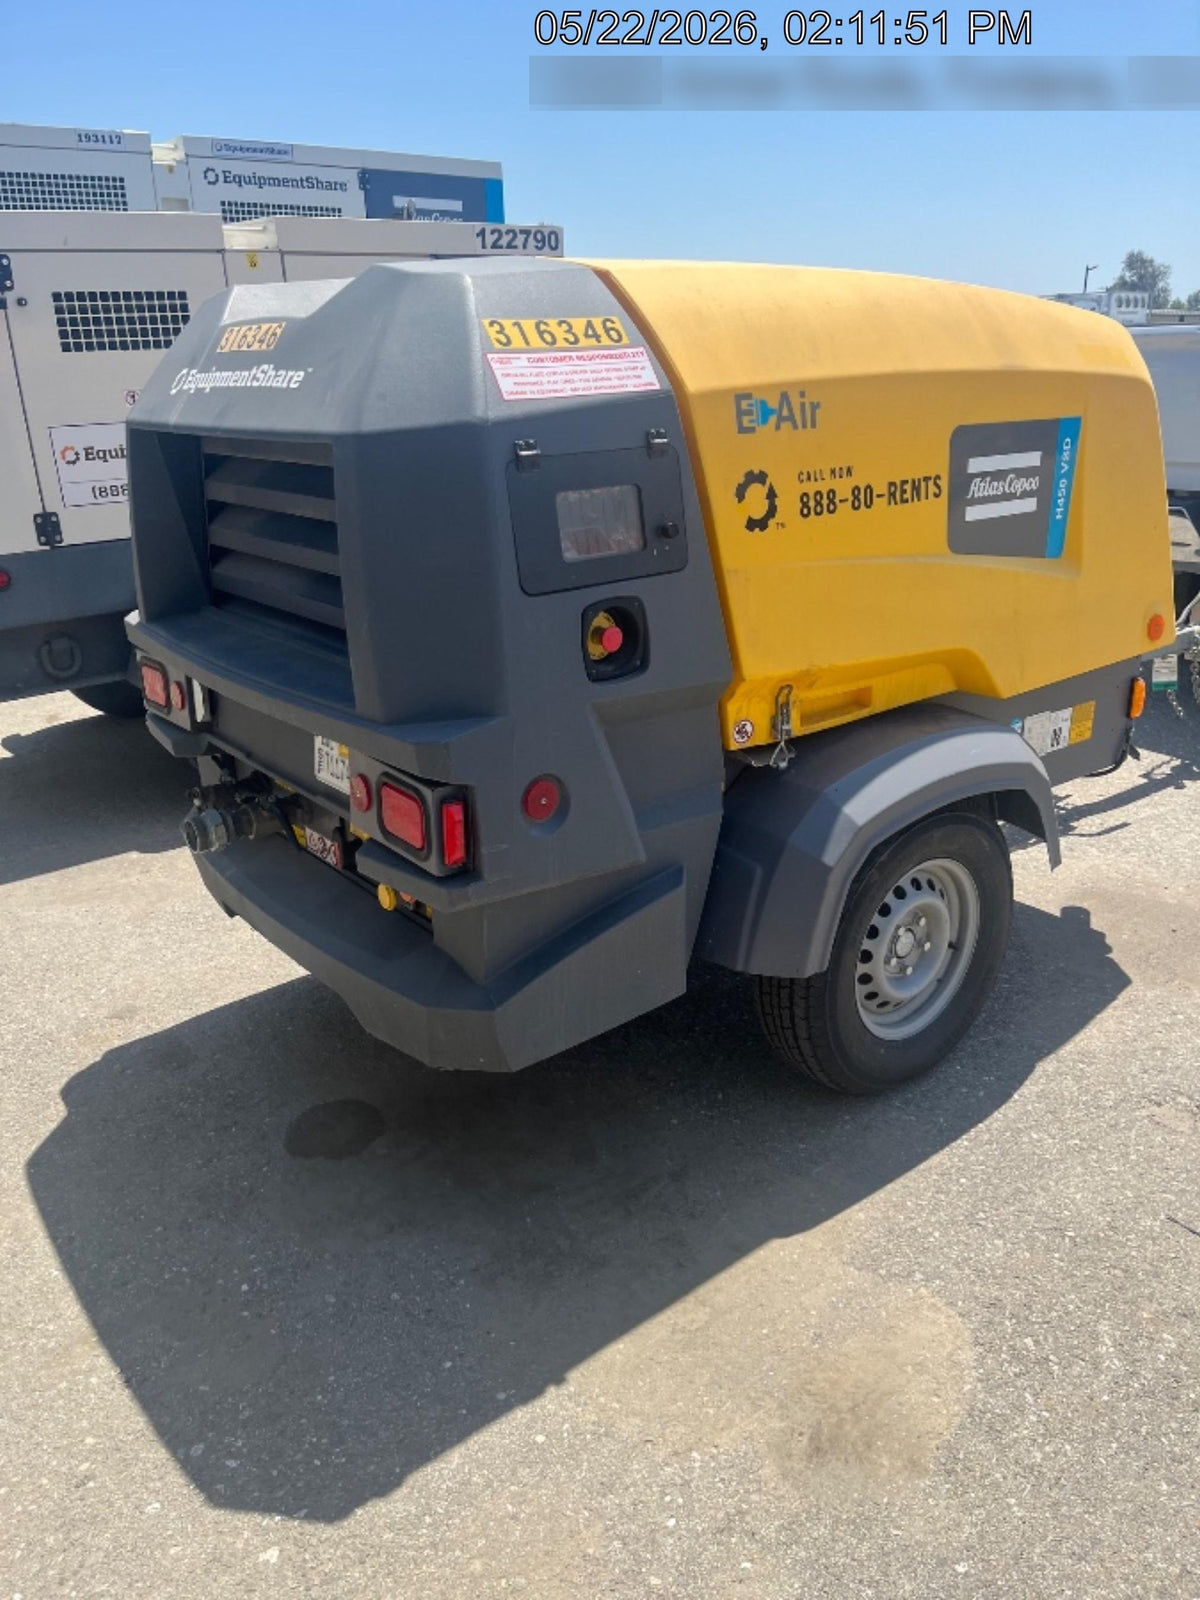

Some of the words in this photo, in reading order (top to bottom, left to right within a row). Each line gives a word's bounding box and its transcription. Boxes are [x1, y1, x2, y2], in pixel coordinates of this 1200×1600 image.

[222, 170, 348, 192] EquipmentShare
[475, 226, 560, 251] 122790
[219, 323, 284, 351] 316346
[488, 317, 624, 347] 316346
[182, 363, 305, 394] EquipmentShare
[797, 470, 826, 484] CALL
[830, 464, 855, 481] NOW
[799, 474, 943, 519] 888-80-RENTS
